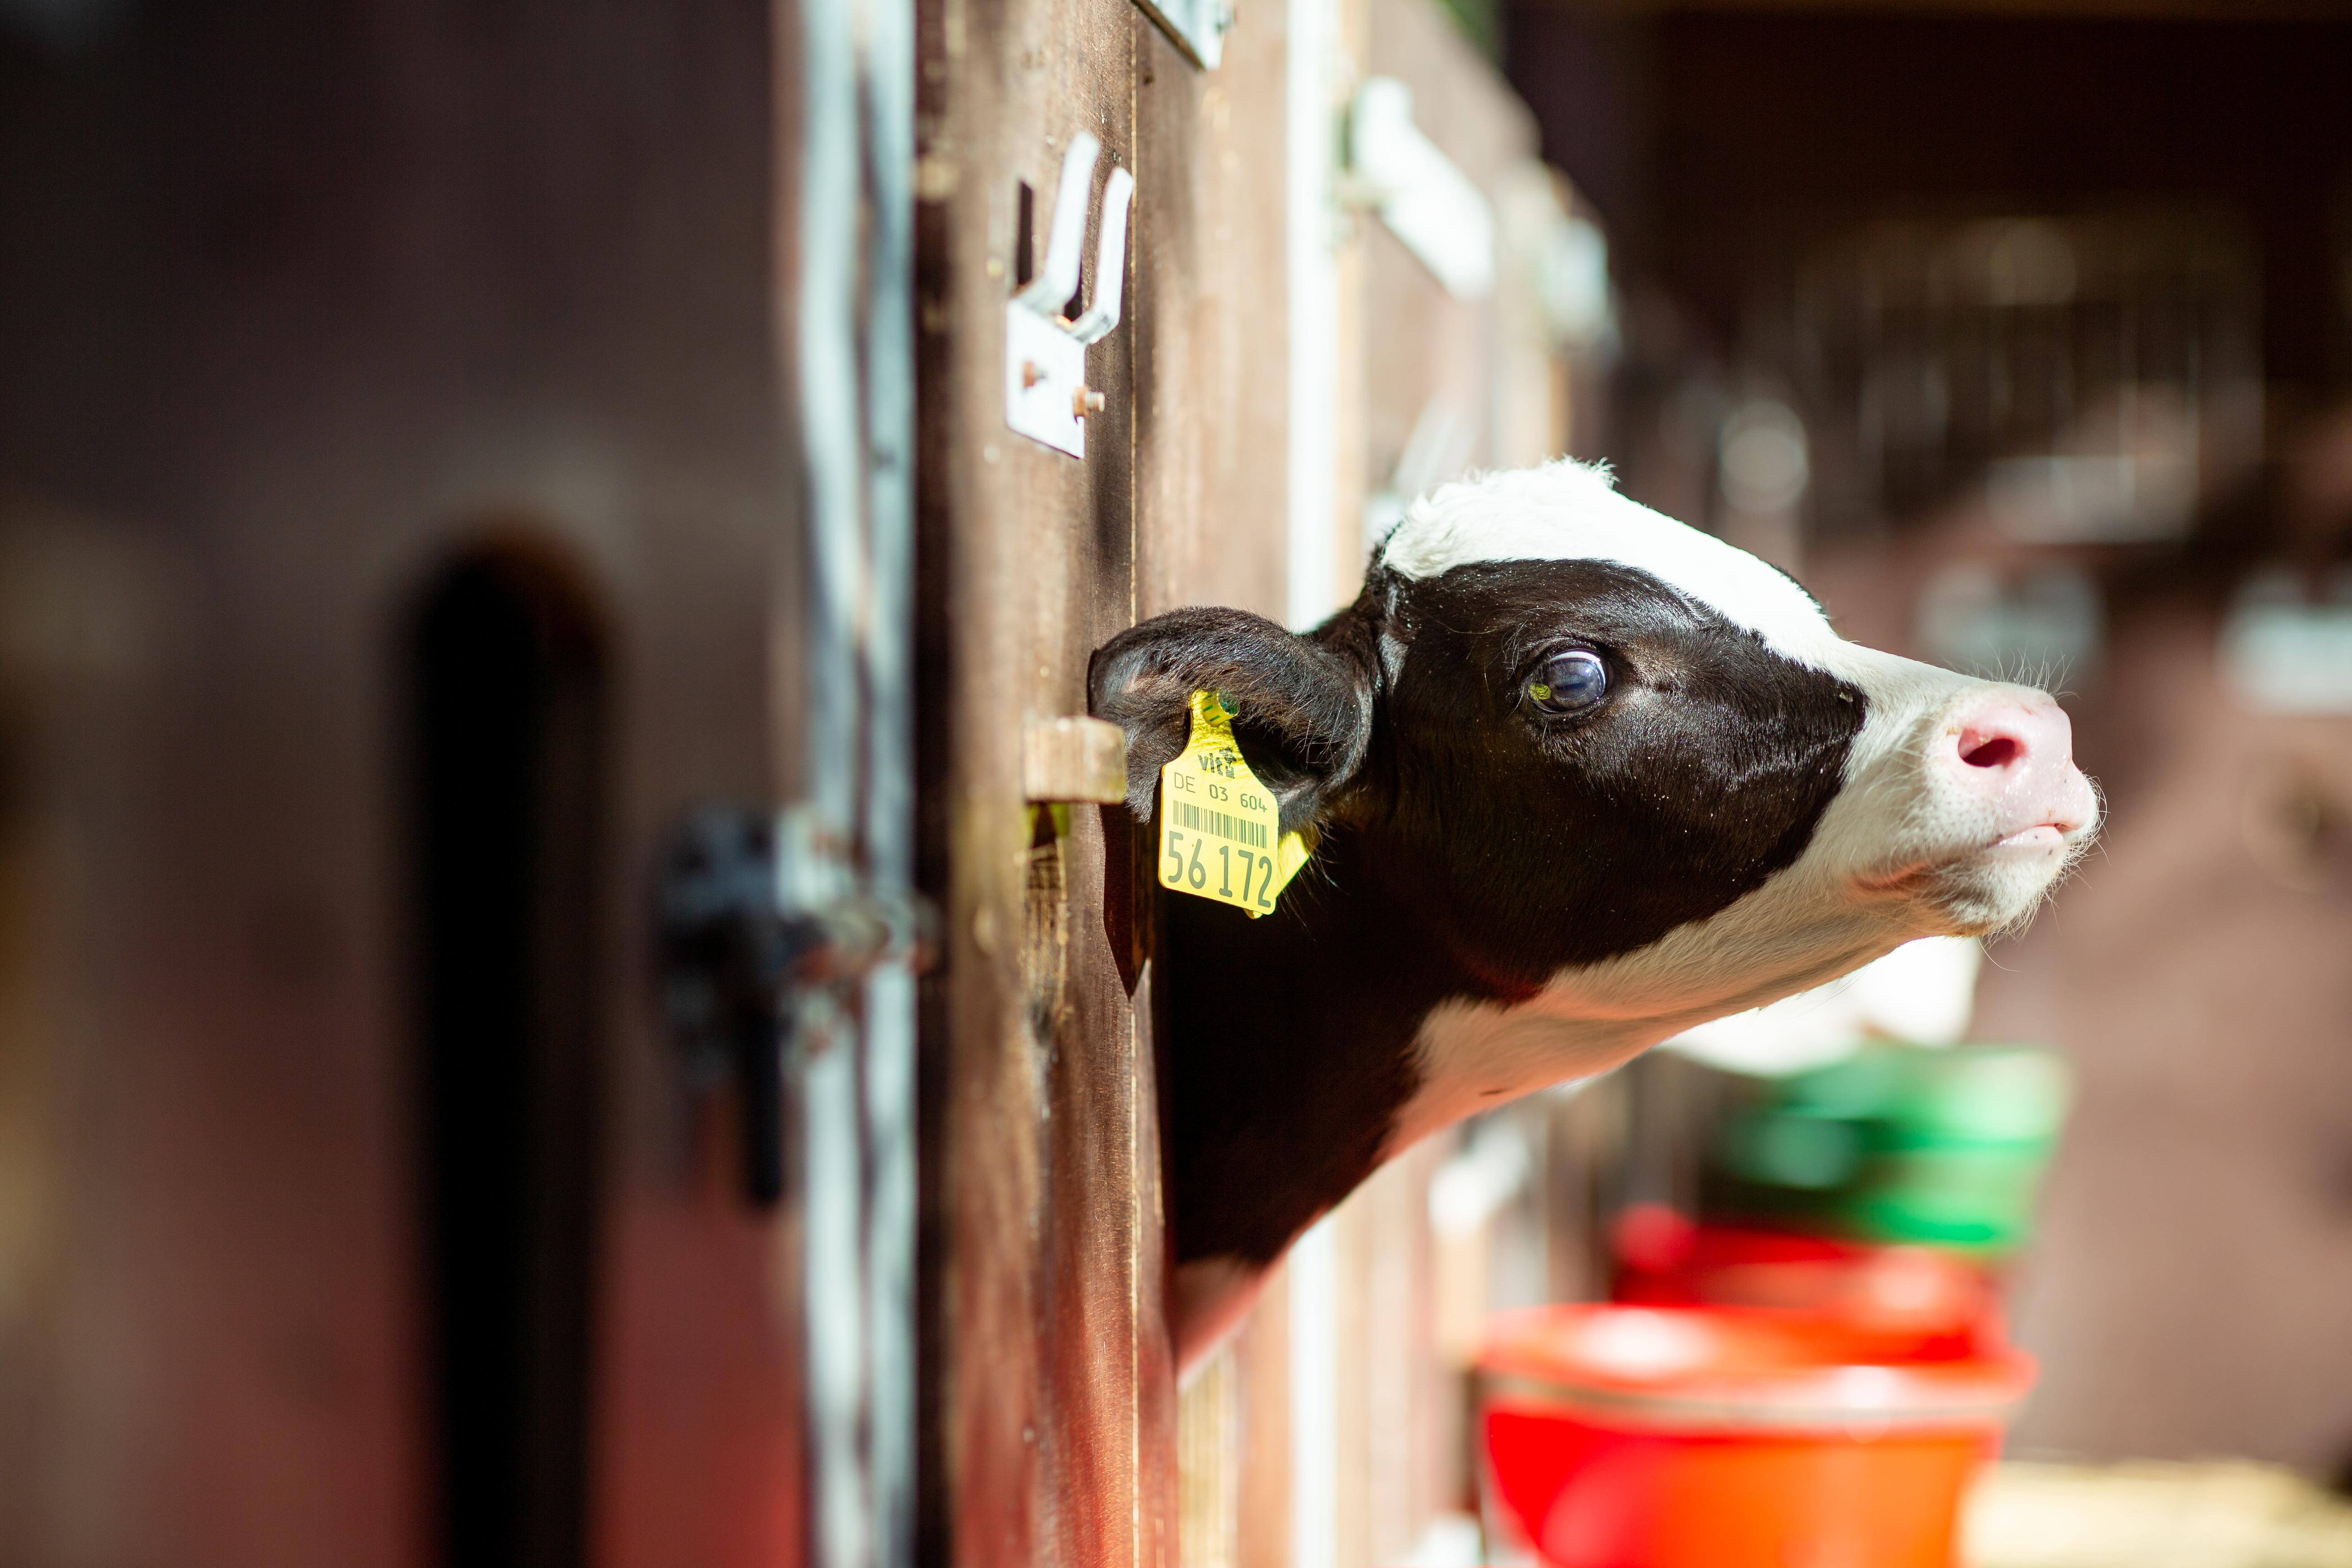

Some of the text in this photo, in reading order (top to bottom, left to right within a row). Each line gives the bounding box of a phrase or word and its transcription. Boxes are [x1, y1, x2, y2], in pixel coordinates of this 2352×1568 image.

[1174, 772, 1267, 813] DE 03 604
[1168, 831, 1272, 908] 56 172
